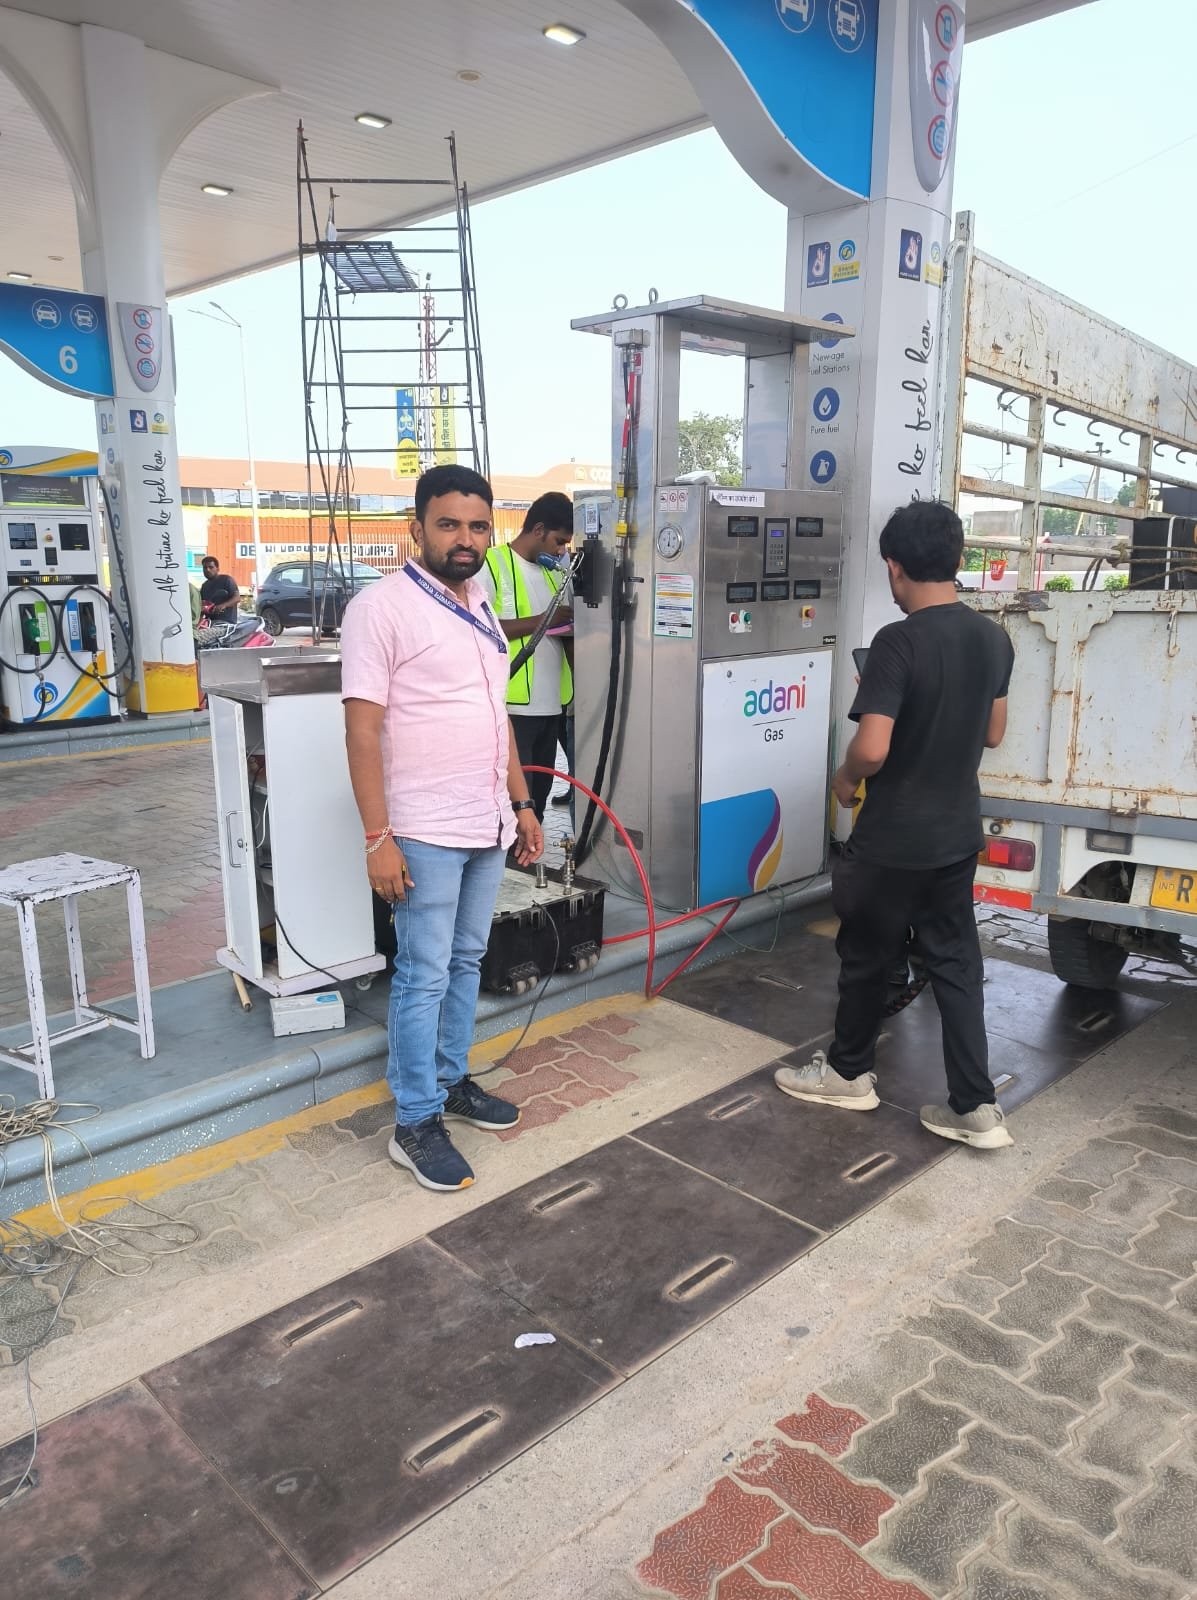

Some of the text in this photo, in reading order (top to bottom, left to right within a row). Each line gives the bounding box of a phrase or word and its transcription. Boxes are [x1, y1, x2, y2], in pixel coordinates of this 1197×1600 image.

[904, 320, 933, 364] kar
[59, 345, 79, 375] 6
[822, 364, 850, 374] Stations
[901, 378, 931, 431] feel
[810, 424, 840, 434] Pure fuel
[142, 450, 166, 472] kar
[143, 478, 173, 505] feel
[147, 510, 171, 527] ko
[155, 532, 180, 570] future
[240, 545, 276, 556] DEHI
[153, 575, 178, 593] Ab
[744, 675, 806, 717] adani
[764, 728, 784, 742] Gas
